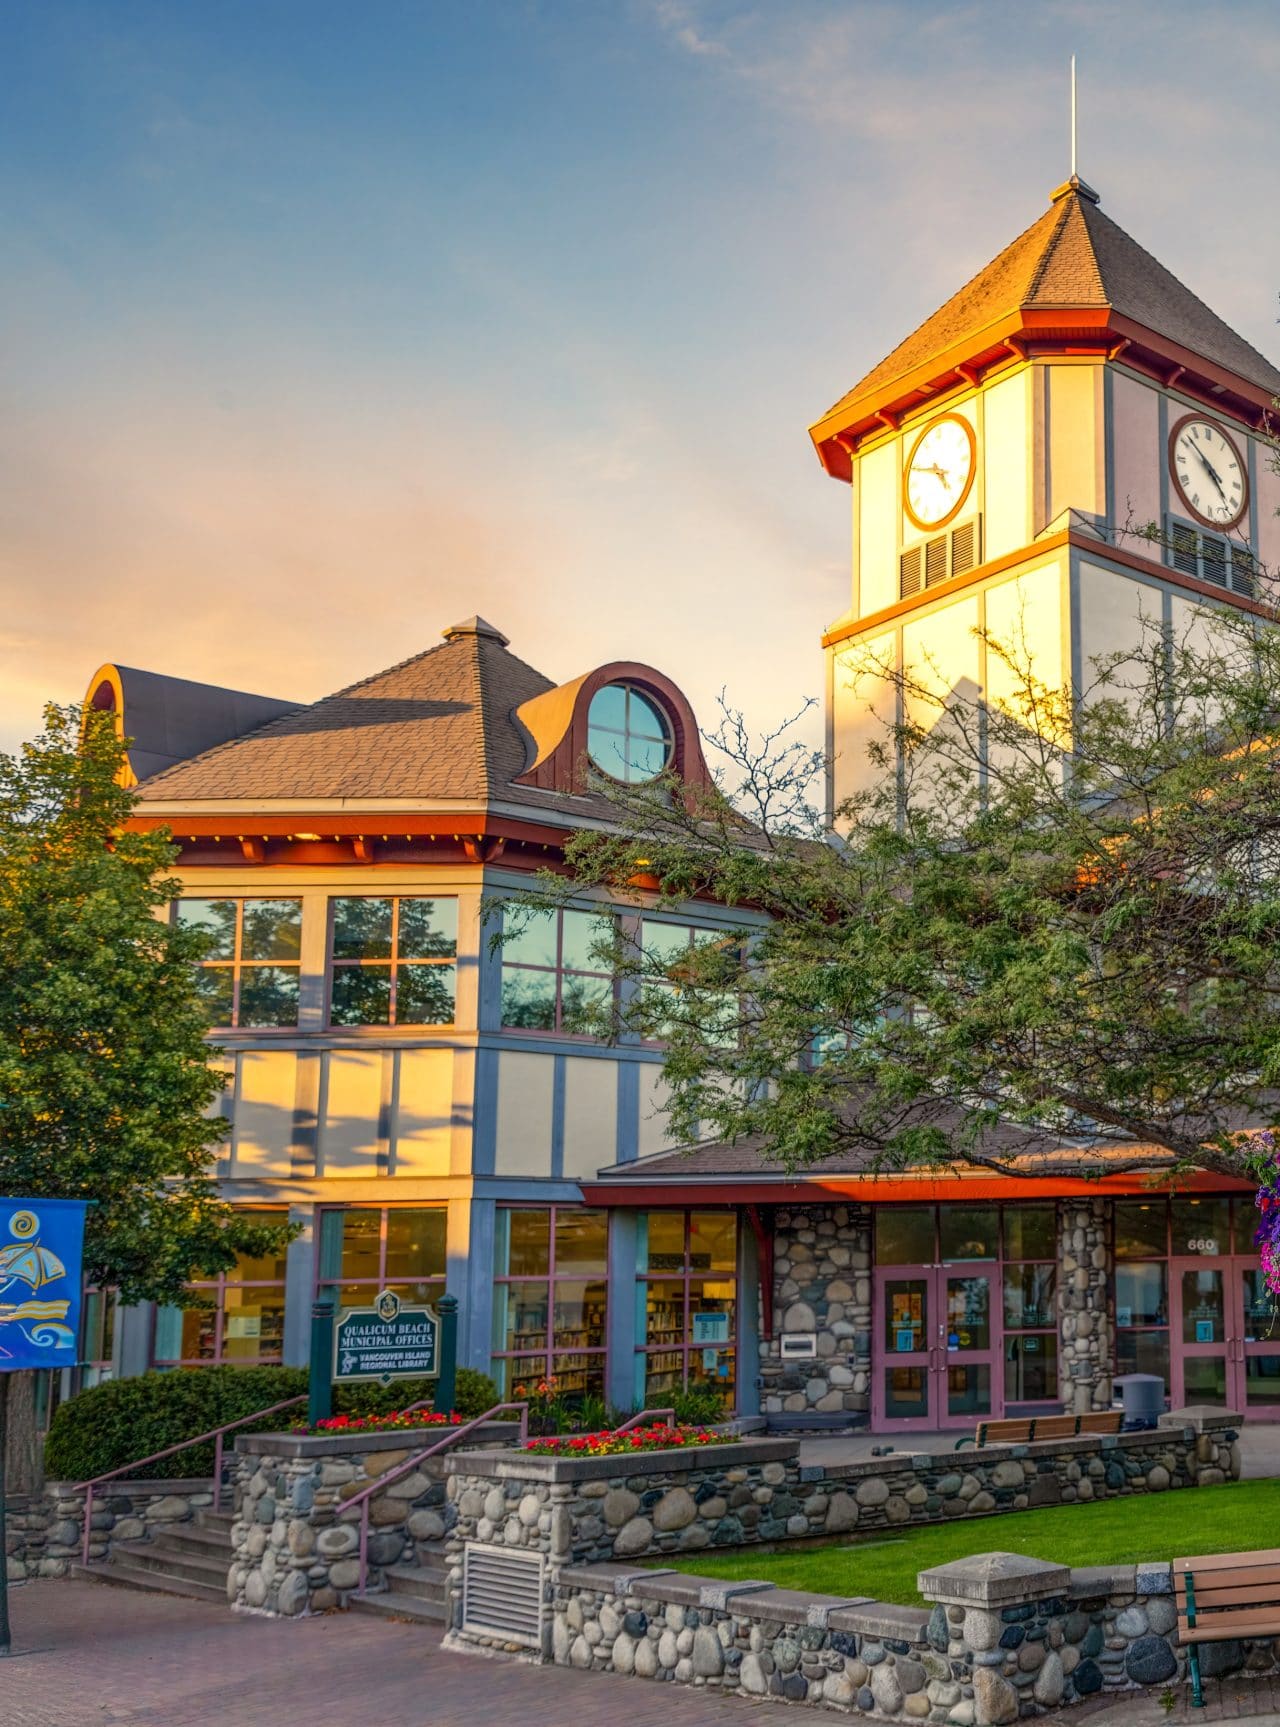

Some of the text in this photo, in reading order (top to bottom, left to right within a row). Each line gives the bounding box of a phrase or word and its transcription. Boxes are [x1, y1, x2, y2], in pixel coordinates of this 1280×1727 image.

[1187, 1239, 1215, 1250] 660
[344, 1323, 431, 1337] QUALICUM BEACH
[342, 1334, 433, 1347] MUNICIPAL OFFICES
[360, 1351, 431, 1361] VANCOUVER ISLAND
[360, 1359, 429, 1370] REGIONAL LIBRARY
